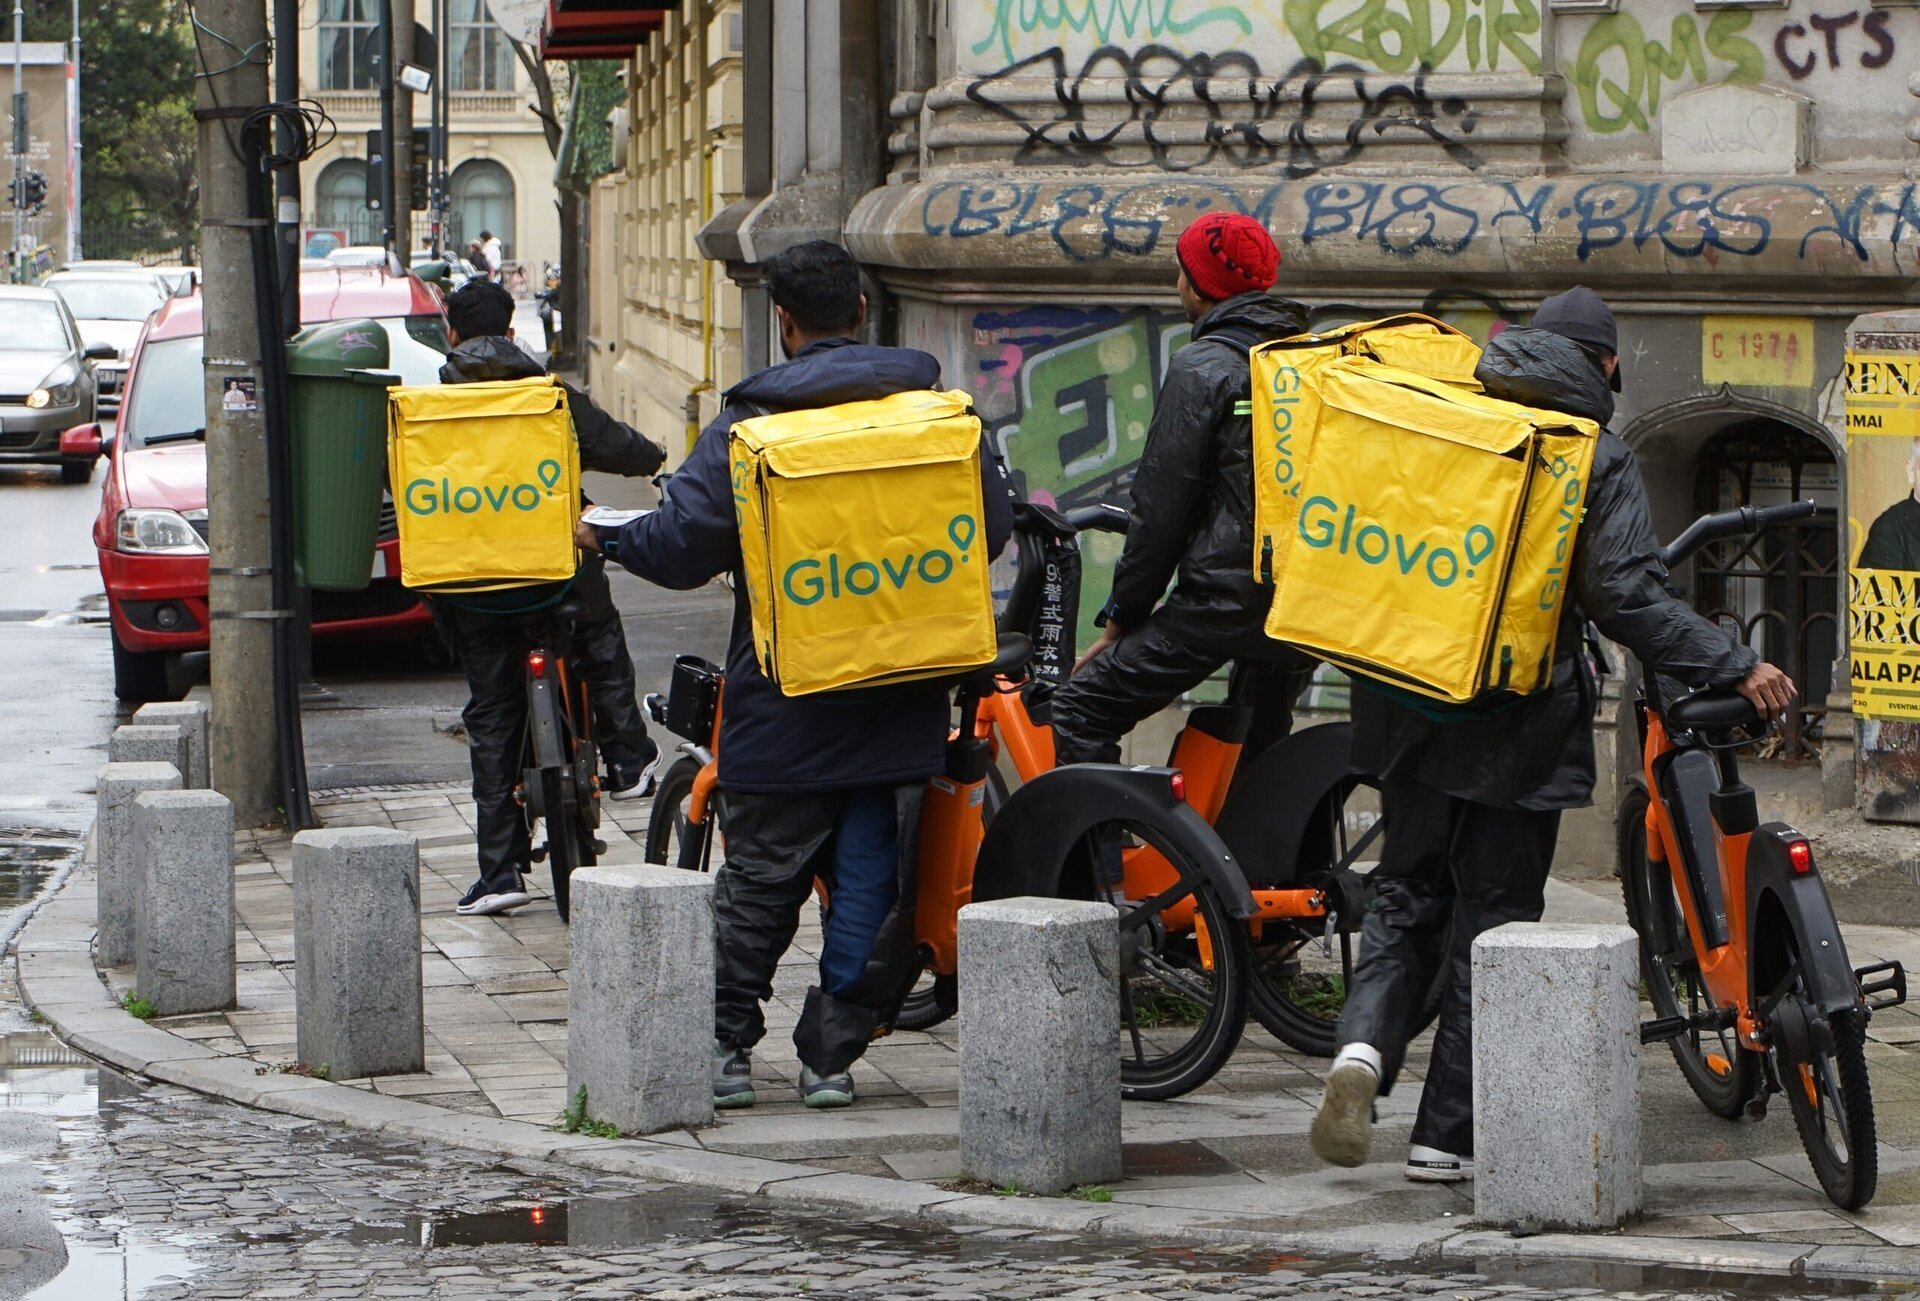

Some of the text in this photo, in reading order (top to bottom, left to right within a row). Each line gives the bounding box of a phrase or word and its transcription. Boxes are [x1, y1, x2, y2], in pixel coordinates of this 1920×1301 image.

[1774, 10, 1895, 80] CTS
[1711, 332, 1724, 359] C
[1272, 364, 1301, 485] Glovo
[1853, 414, 1883, 428] MAI
[405, 476, 541, 516] Glovo
[1298, 495, 1460, 588] Glovo
[1540, 477, 1581, 611] Glovo
[783, 549, 954, 606] Glovo
